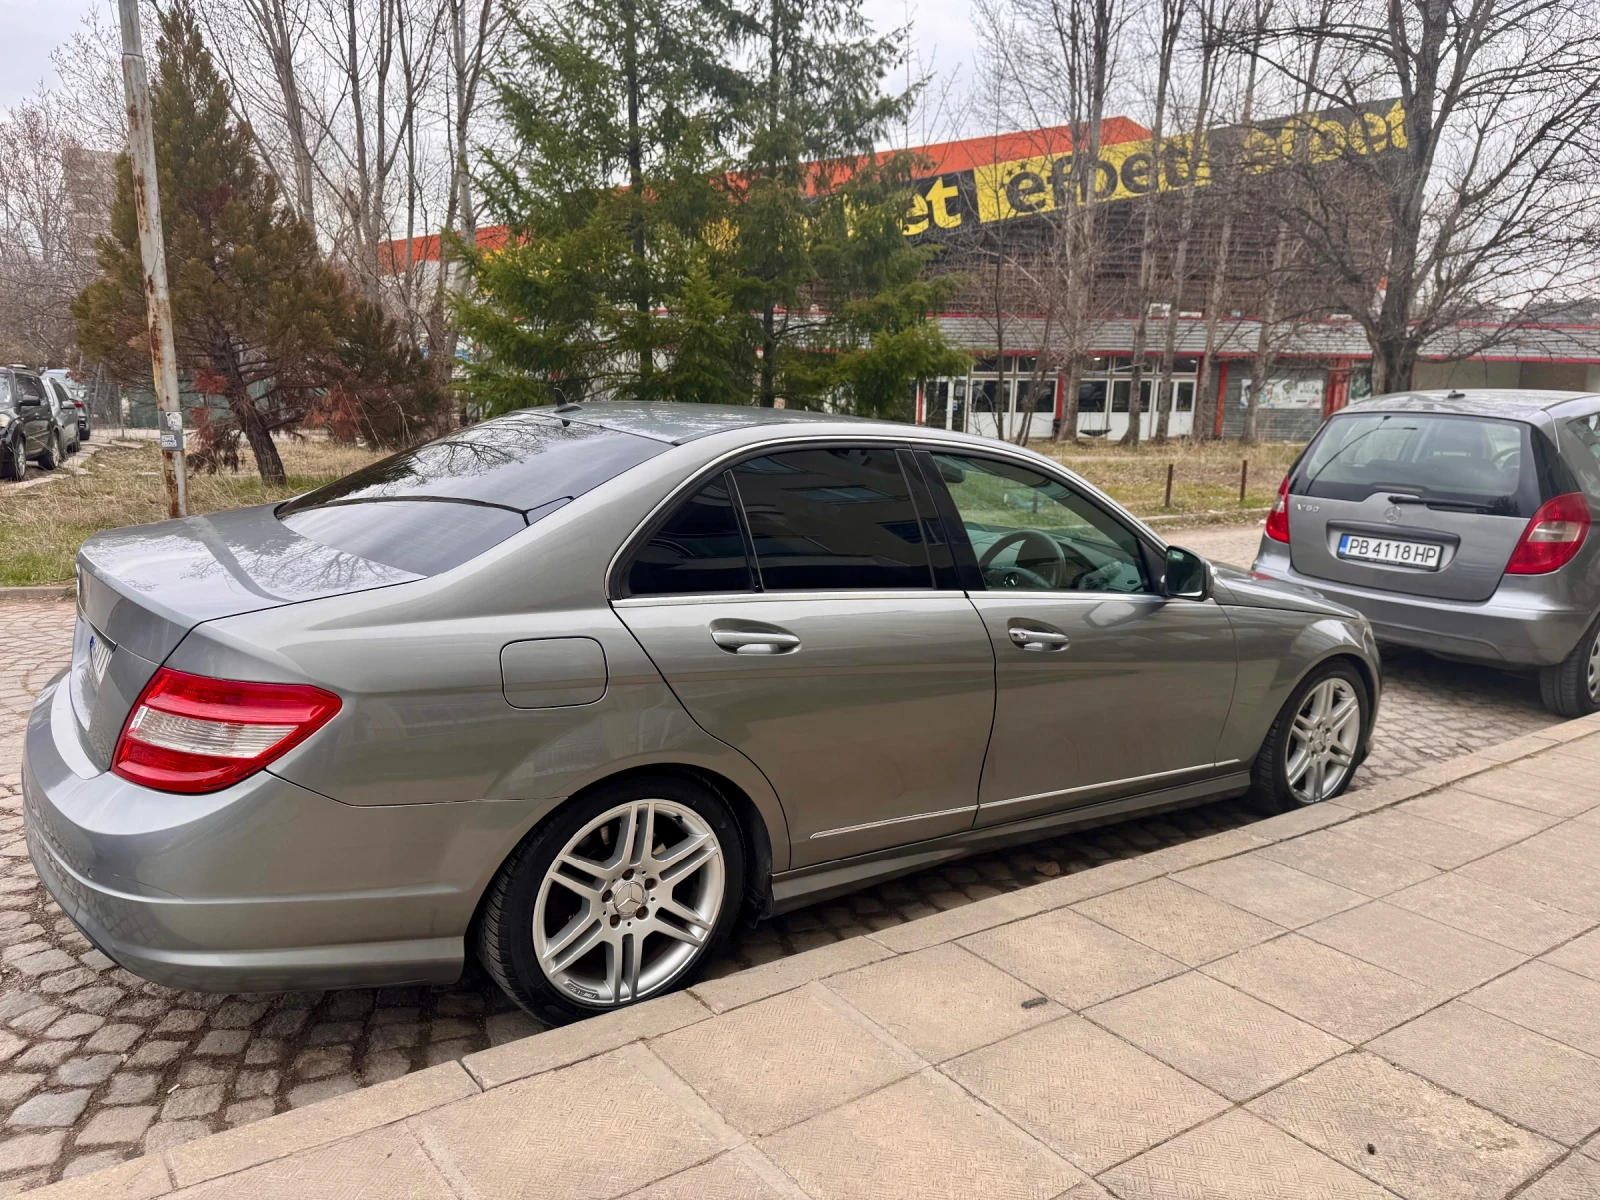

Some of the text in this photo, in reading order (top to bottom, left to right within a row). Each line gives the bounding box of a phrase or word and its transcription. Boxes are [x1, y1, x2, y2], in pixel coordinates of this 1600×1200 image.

[1006, 142, 1196, 213] efbet
[1243, 99, 1409, 175] efbet
[1348, 538, 1370, 555] PB
[1372, 541, 1412, 561] 4118
[1413, 546, 1437, 563] HP
